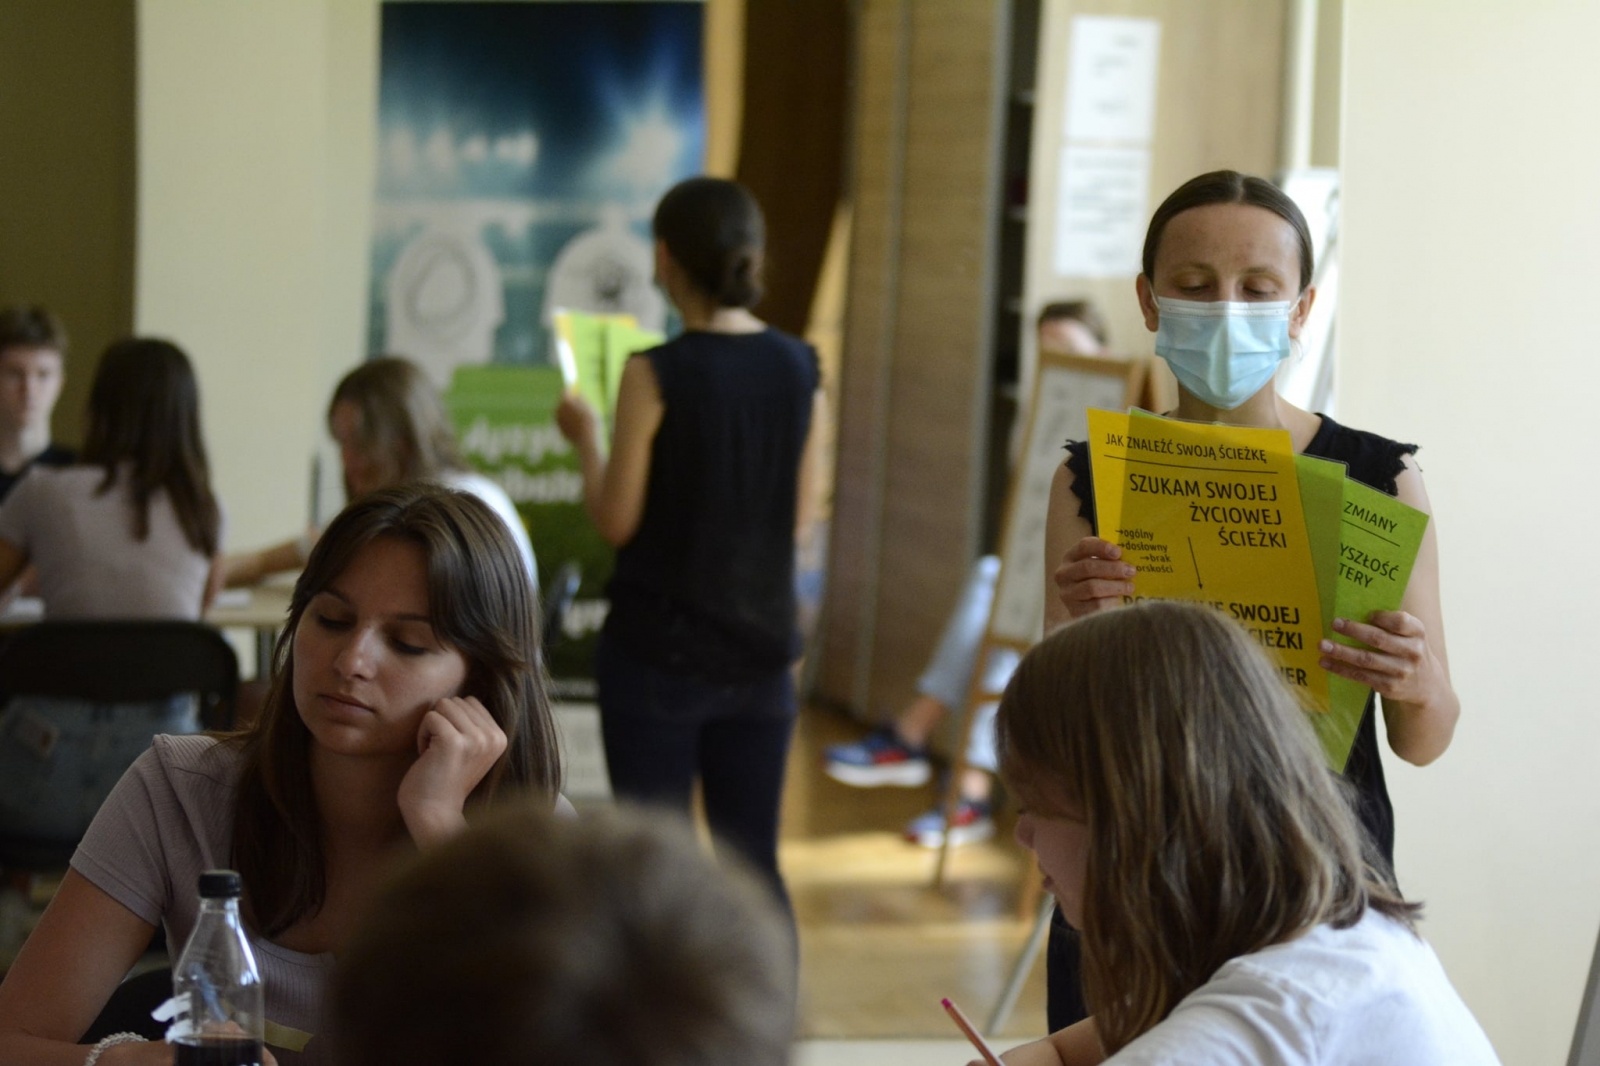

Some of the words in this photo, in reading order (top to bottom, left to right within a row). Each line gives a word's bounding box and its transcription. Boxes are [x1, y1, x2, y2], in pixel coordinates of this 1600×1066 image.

[1105, 433, 1124, 447] JAK
[1127, 436, 1174, 454] ZNALEŹĆ
[1177, 443, 1217, 461] SWOJĄ
[1219, 444, 1267, 464] ŚCIEŻKĘ
[1129, 473, 1200, 498] SZUKAM
[1205, 481, 1277, 501] SWOJEJ
[1189, 501, 1282, 525] ŻYCIOWEJ
[1343, 501, 1398, 533] ZMIANY
[1124, 528, 1154, 541] ogólny
[1218, 526, 1287, 548] ŚCIEŻKI
[1125, 541, 1168, 553] dosłowny
[1149, 554, 1171, 563] brak
[1136, 564, 1174, 574] orskości
[1340, 542, 1399, 581] YSZŁOŚĆ
[1338, 562, 1373, 588] TERY
[1229, 602, 1300, 625] SWOJEJ
